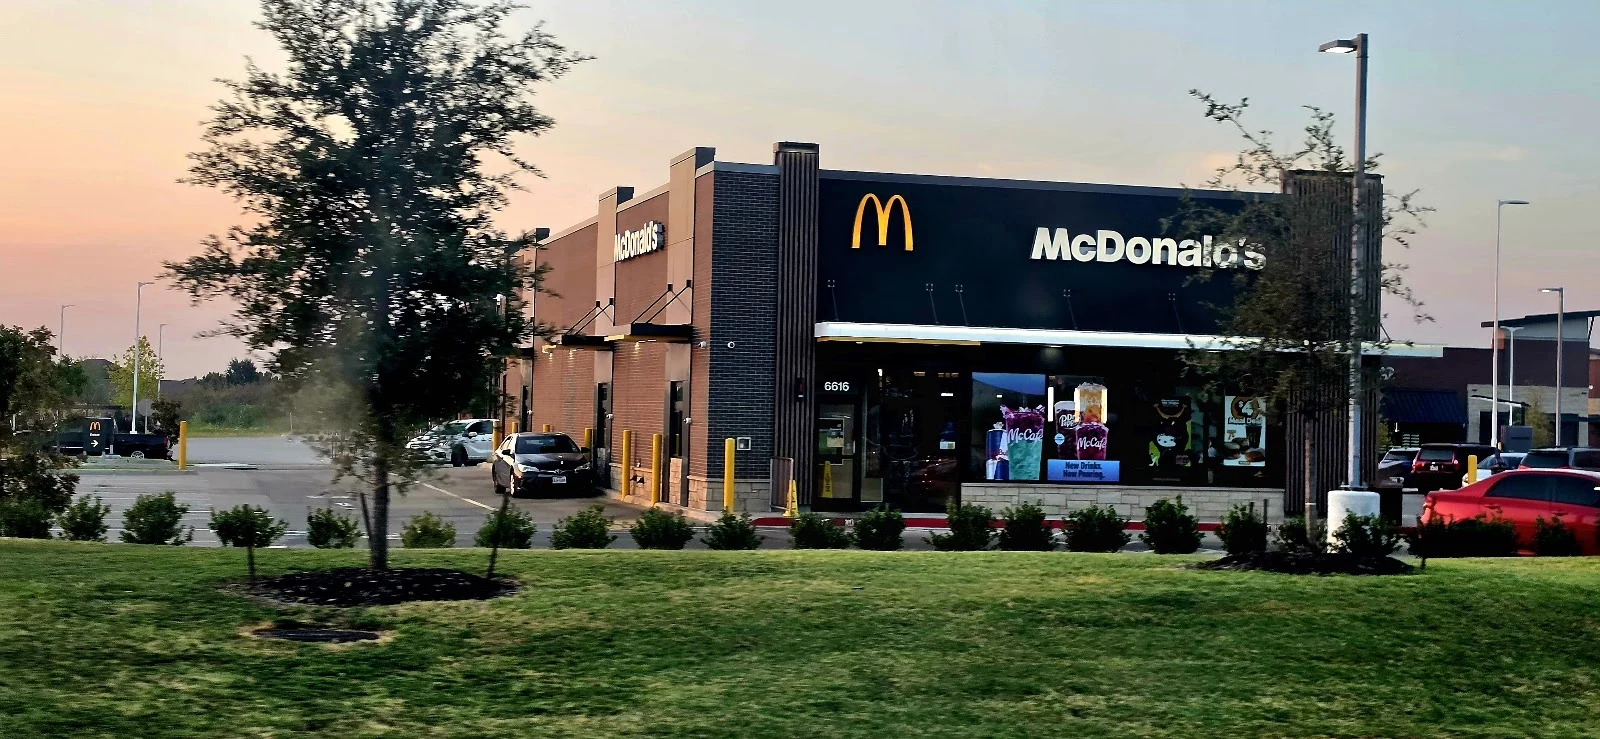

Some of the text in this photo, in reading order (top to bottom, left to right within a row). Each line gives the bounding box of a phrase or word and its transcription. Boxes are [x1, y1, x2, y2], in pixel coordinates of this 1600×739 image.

[613, 220, 659, 263] McDonald's
[1030, 226, 1268, 271] McDonald's
[824, 381, 850, 392] 6616
[1065, 461, 1080, 470] New
